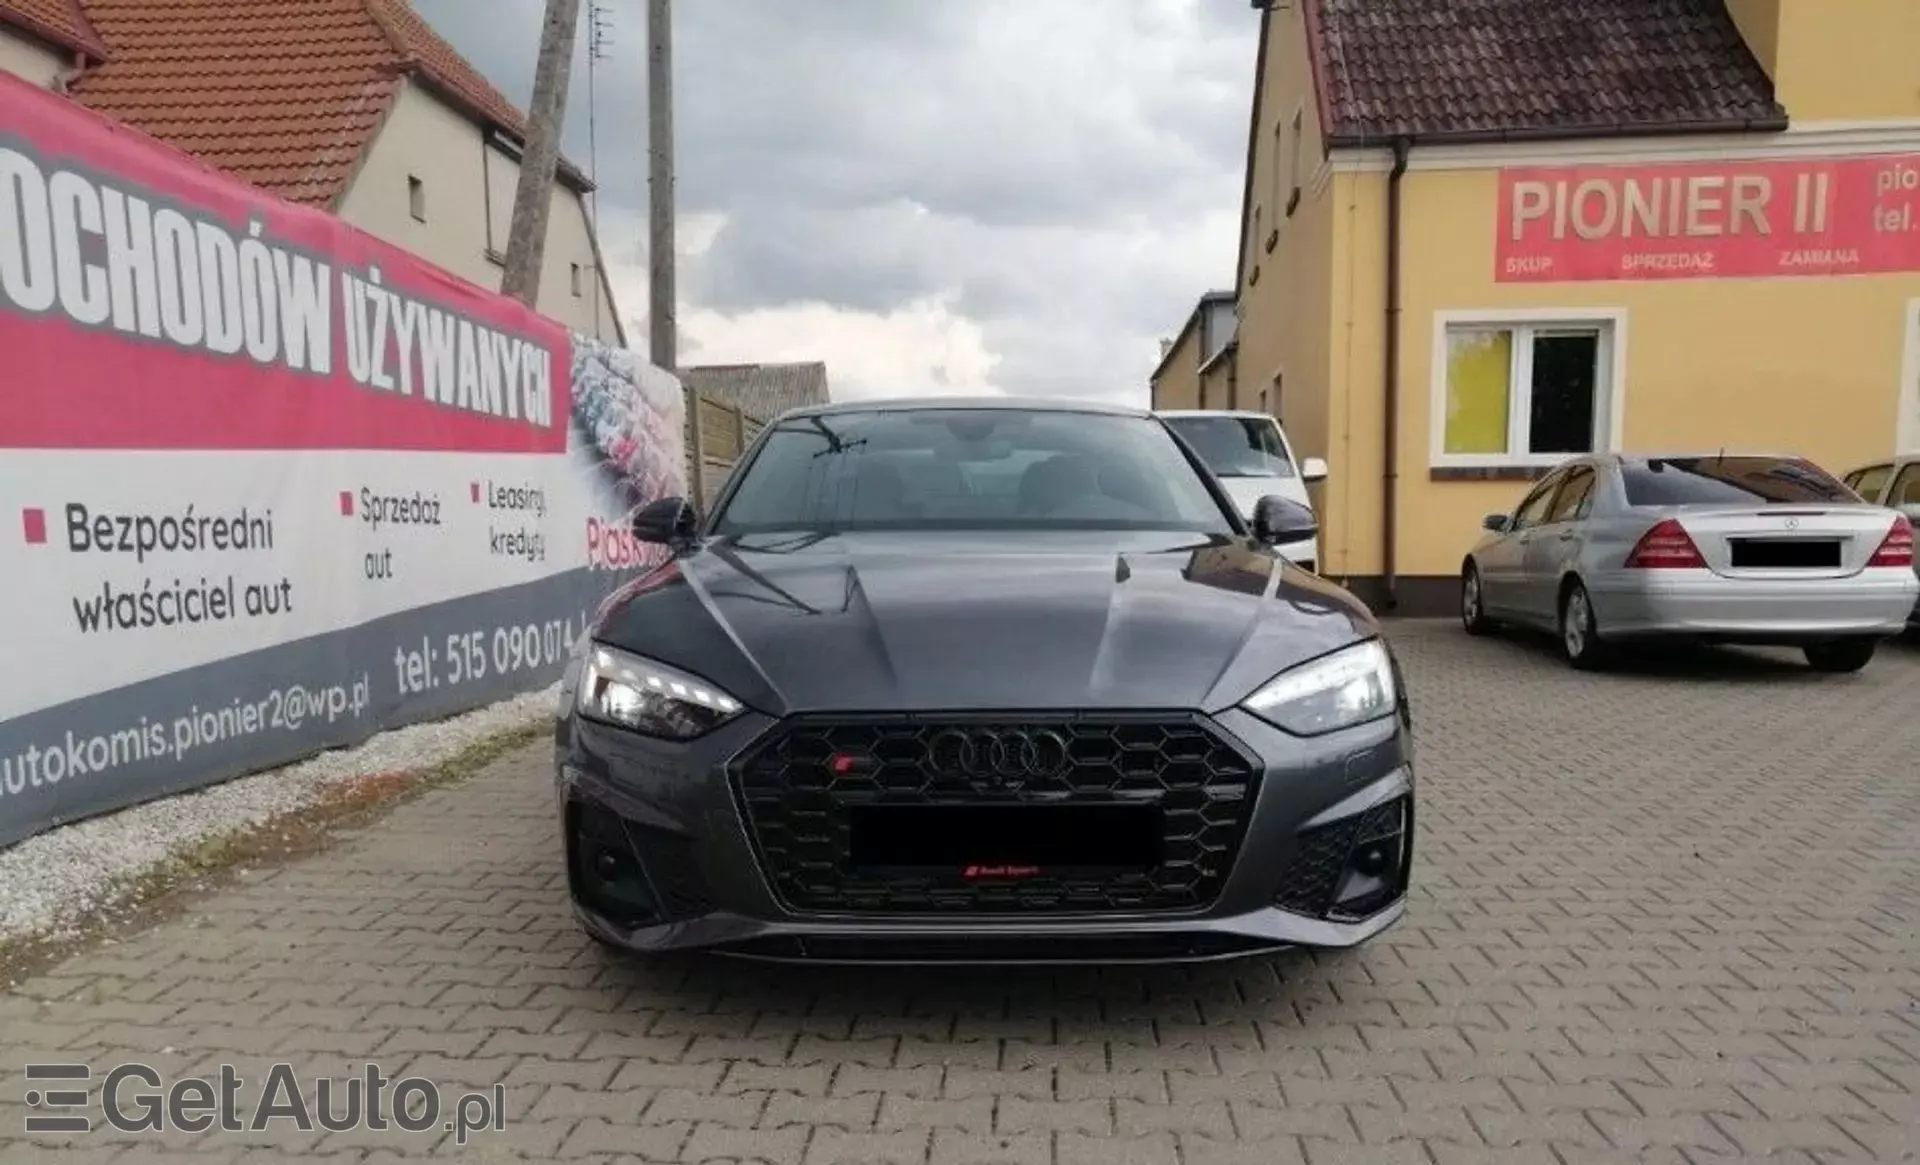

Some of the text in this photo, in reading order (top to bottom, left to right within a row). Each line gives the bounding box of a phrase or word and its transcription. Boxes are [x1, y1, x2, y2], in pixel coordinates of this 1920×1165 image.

[1511, 173, 1829, 241] PIONIER II
[0, 147, 551, 428] OCHODÓW UŻYWANYCH
[1506, 256, 1553, 273] SKUP
[1779, 248, 1860, 267] ZAMIANA
[66, 503, 273, 563] Bezpośredni
[361, 486, 441, 532] Sprzedaż
[365, 547, 393, 579] aut
[73, 575, 293, 634] właściciel aut
[395, 635, 440, 694] tel:
[447, 631, 487, 684] 515
[493, 622, 541, 675] 090
[0, 672, 370, 797] utokomis.pionier2@wp.pl
